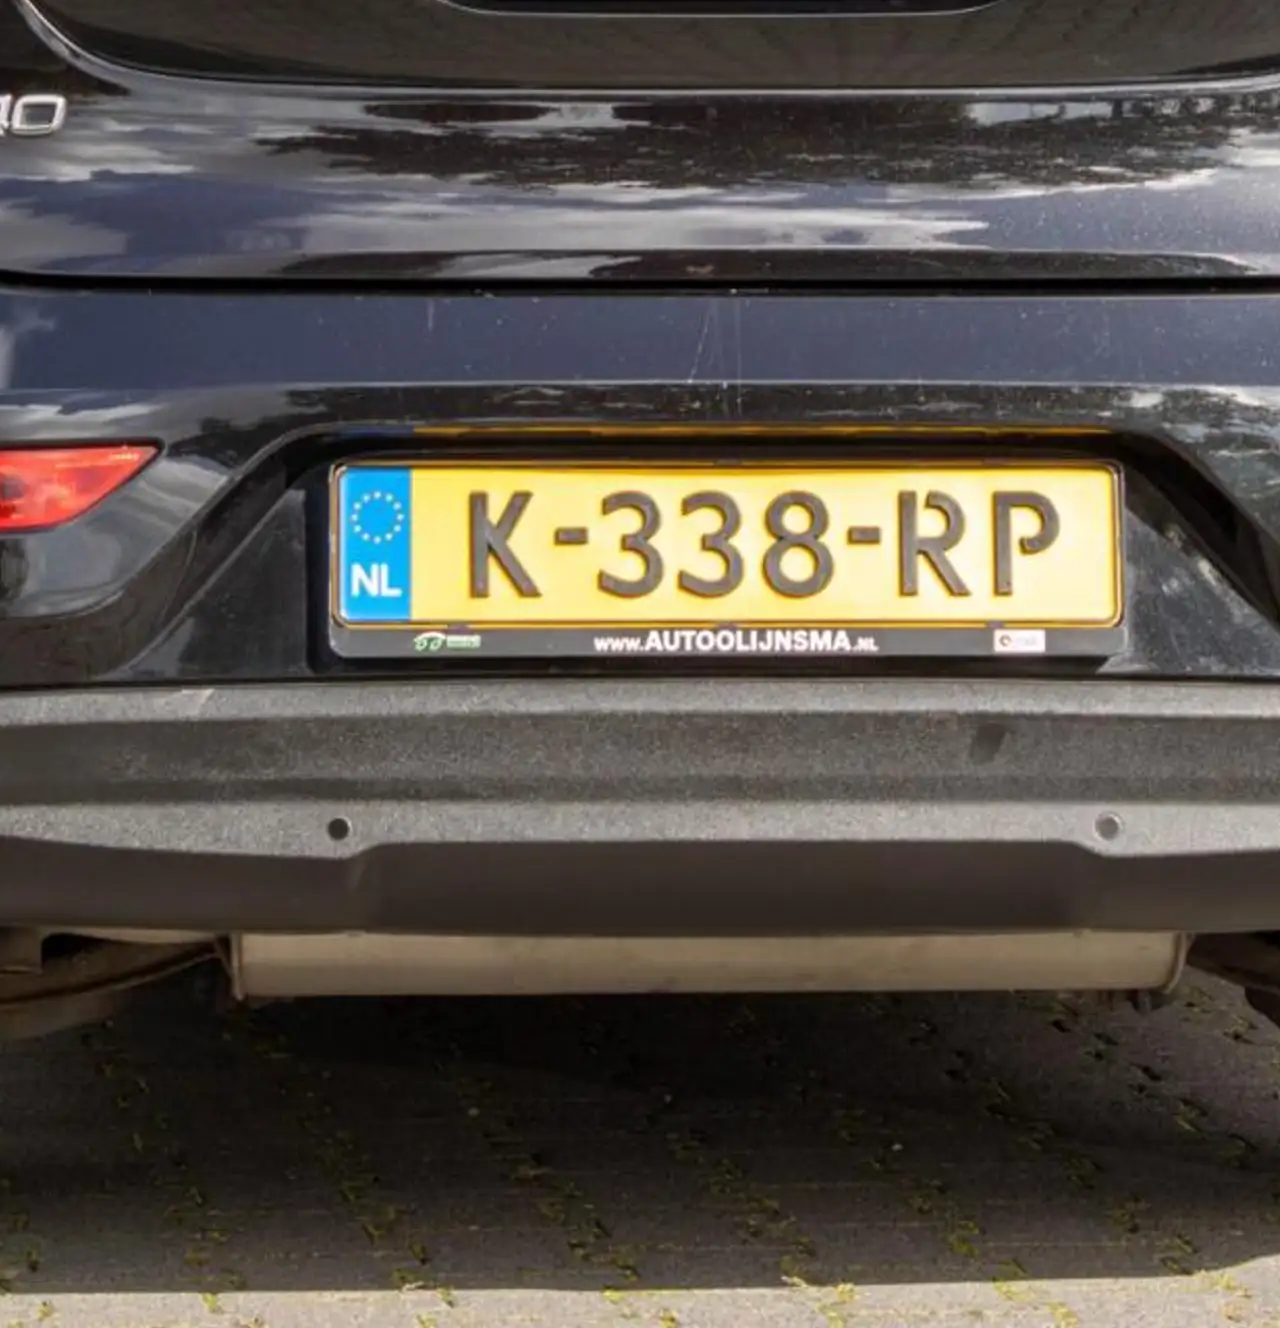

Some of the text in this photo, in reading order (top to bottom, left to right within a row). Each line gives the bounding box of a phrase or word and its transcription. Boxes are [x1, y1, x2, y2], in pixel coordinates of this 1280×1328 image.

[467, 489, 1061, 599] K-338-RP
[351, 563, 402, 597] NL
[593, 630, 878, 652] www.AUTOOLIJNSMA.NL
